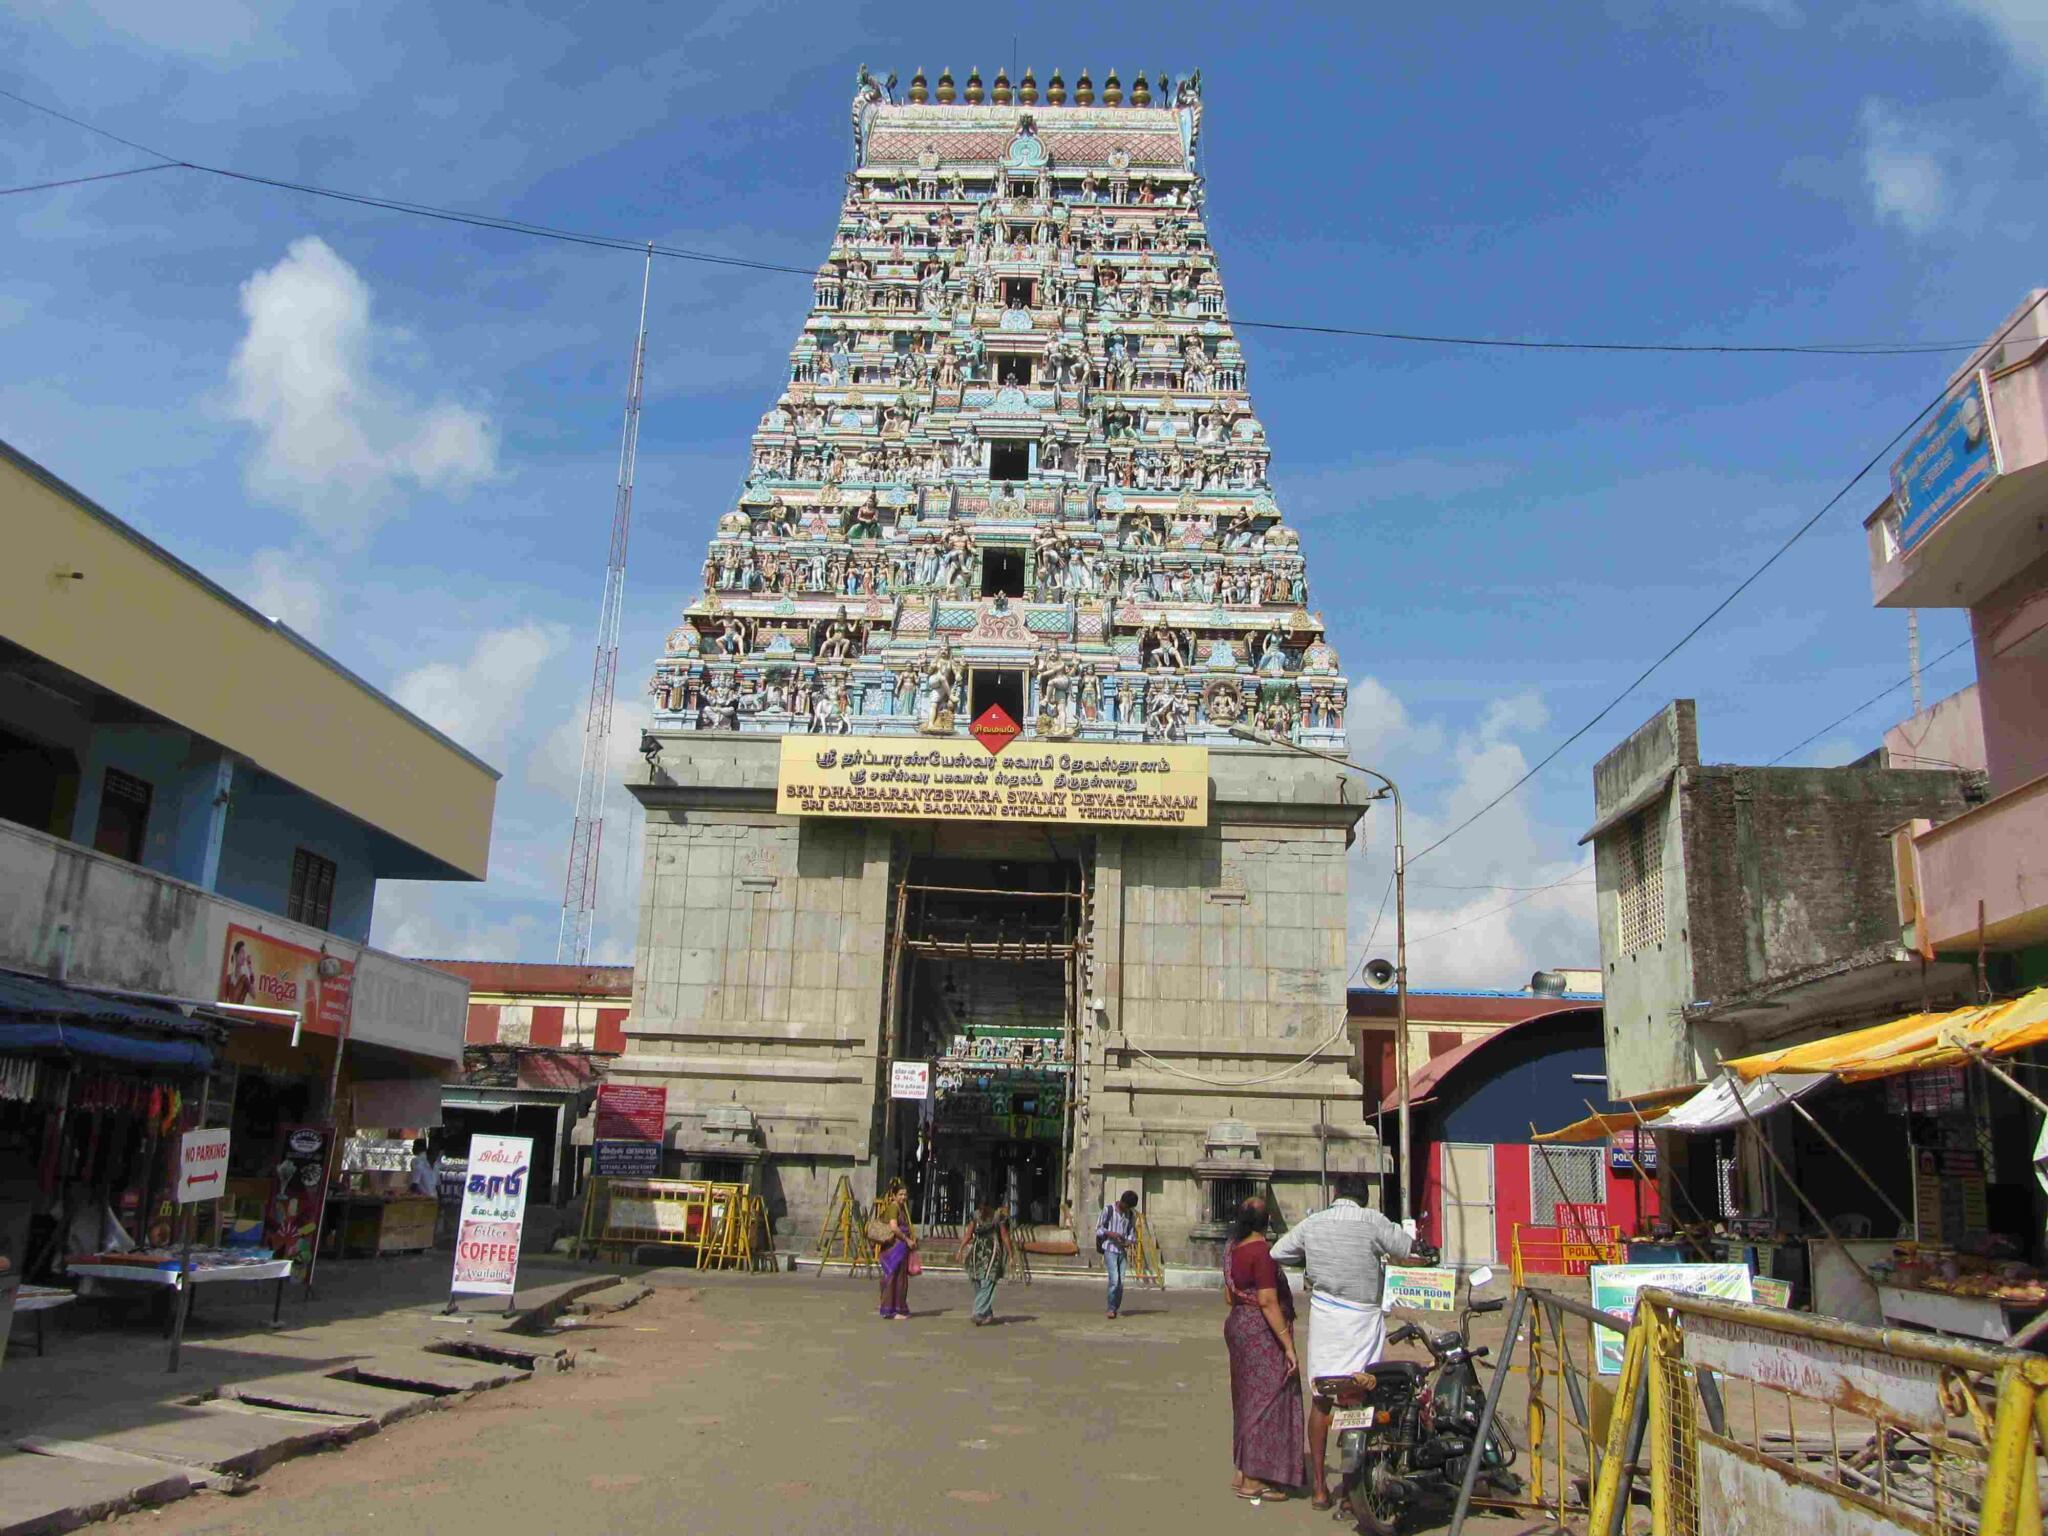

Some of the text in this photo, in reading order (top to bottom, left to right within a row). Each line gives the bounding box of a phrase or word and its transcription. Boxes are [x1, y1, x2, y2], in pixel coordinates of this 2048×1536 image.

[1002, 754, 1053, 771] சுவாமி
[786, 784, 1198, 809] SRI DHARBARANYESWARA SWAMY DEVASTHANAM
[801, 799, 1185, 822] SRI SANEESWARA BAGHAVAN STHALAM THIRUNALLARU
[258, 974, 297, 1001] maaza
[918, 1070, 927, 1082] 1
[185, 1142, 227, 1162] NO PARKING
[478, 1149, 523, 1165] பில்டர்
[467, 1165, 529, 1199] காபி
[470, 1205, 516, 1220] கிடைக்கும்
[474, 1225, 507, 1238] Filter
[460, 1242, 517, 1263] COFFEE
[1392, 1287, 1451, 1298] CLOAK ROOM
